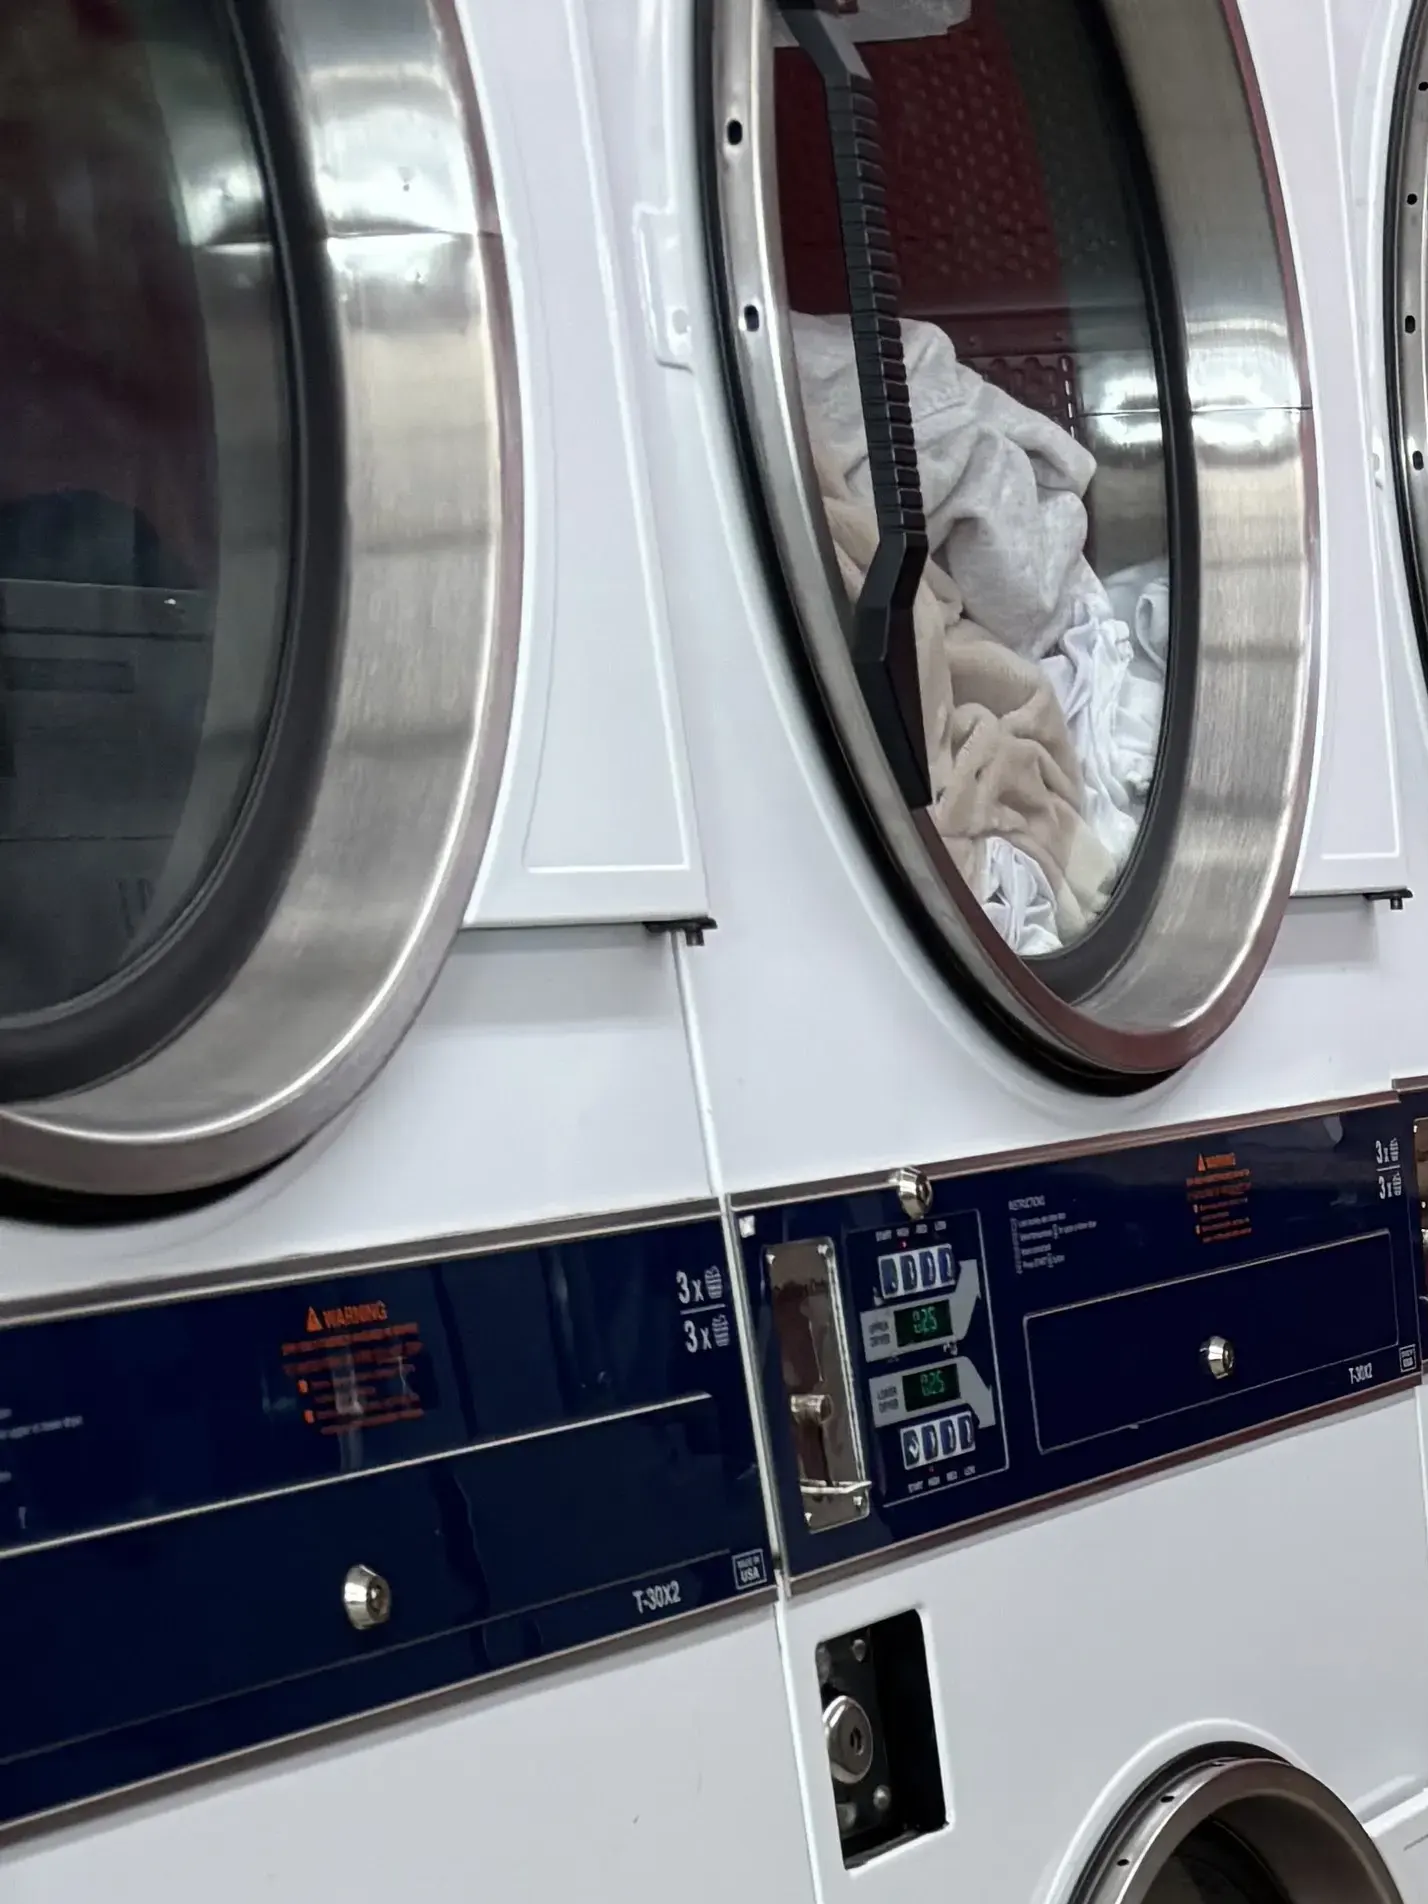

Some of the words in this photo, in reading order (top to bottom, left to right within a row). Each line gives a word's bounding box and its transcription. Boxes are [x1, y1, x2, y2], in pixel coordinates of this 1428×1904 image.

[322, 1300, 389, 1329] WARNING
[740, 1566, 761, 1583] USA
[631, 1579, 682, 1614] T-30X2
